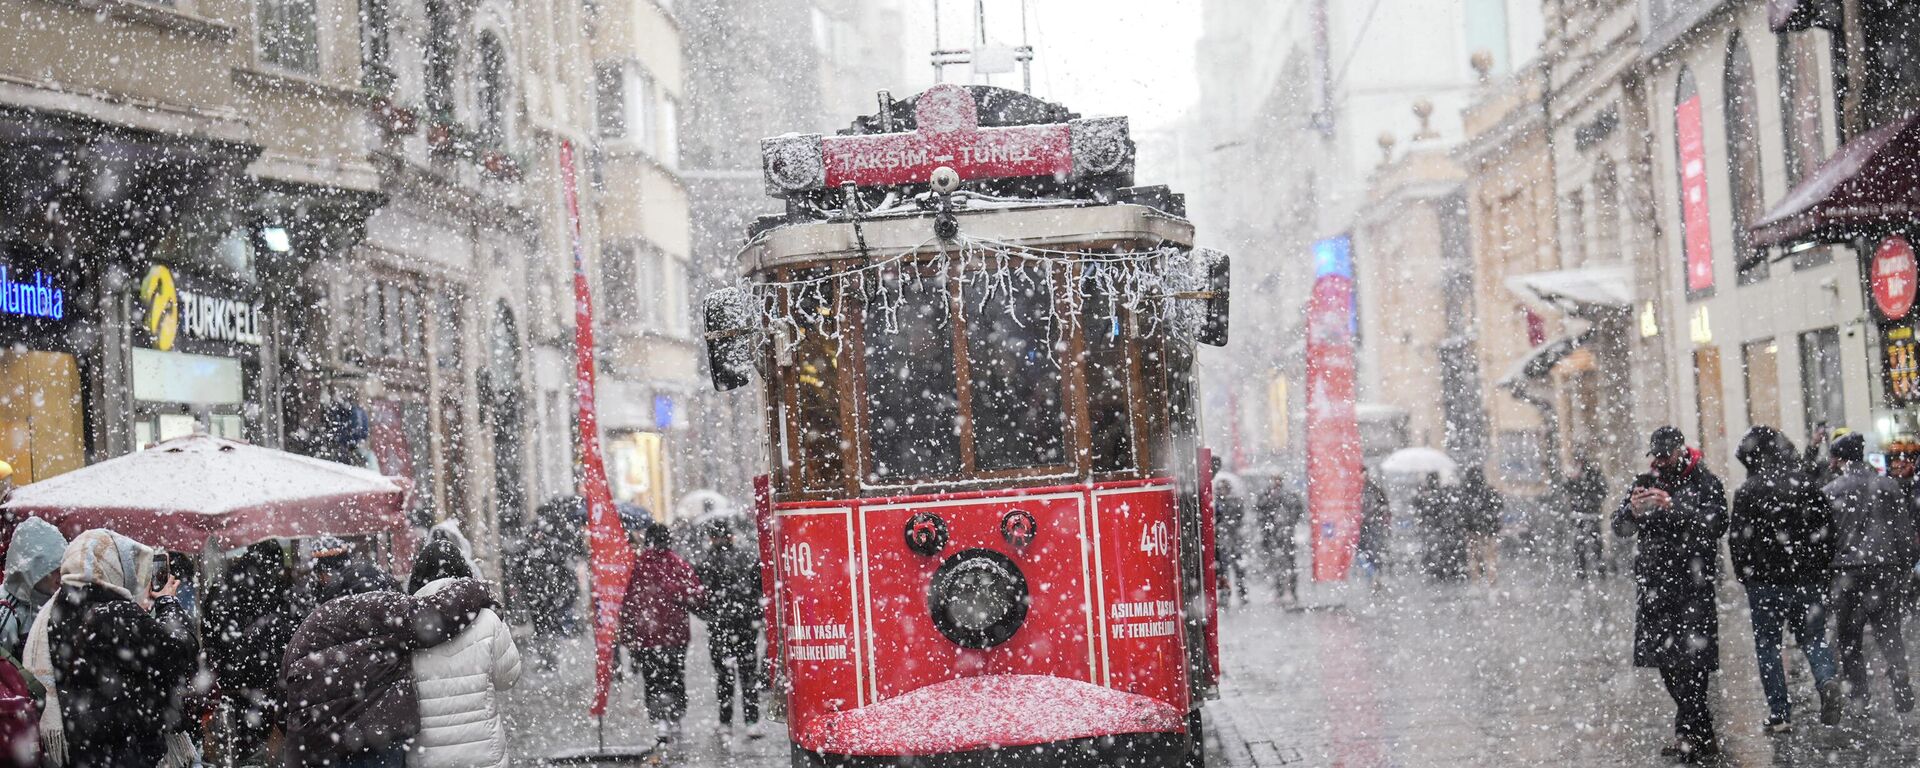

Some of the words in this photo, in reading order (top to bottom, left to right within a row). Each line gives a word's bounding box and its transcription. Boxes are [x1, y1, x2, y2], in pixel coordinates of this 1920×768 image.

[0, 265, 63, 320] lumbia
[1141, 520, 1168, 557] 410
[1111, 601, 1154, 619] ASILMAK
[813, 623, 847, 639] YASAK
[1111, 624, 1125, 639] VE
